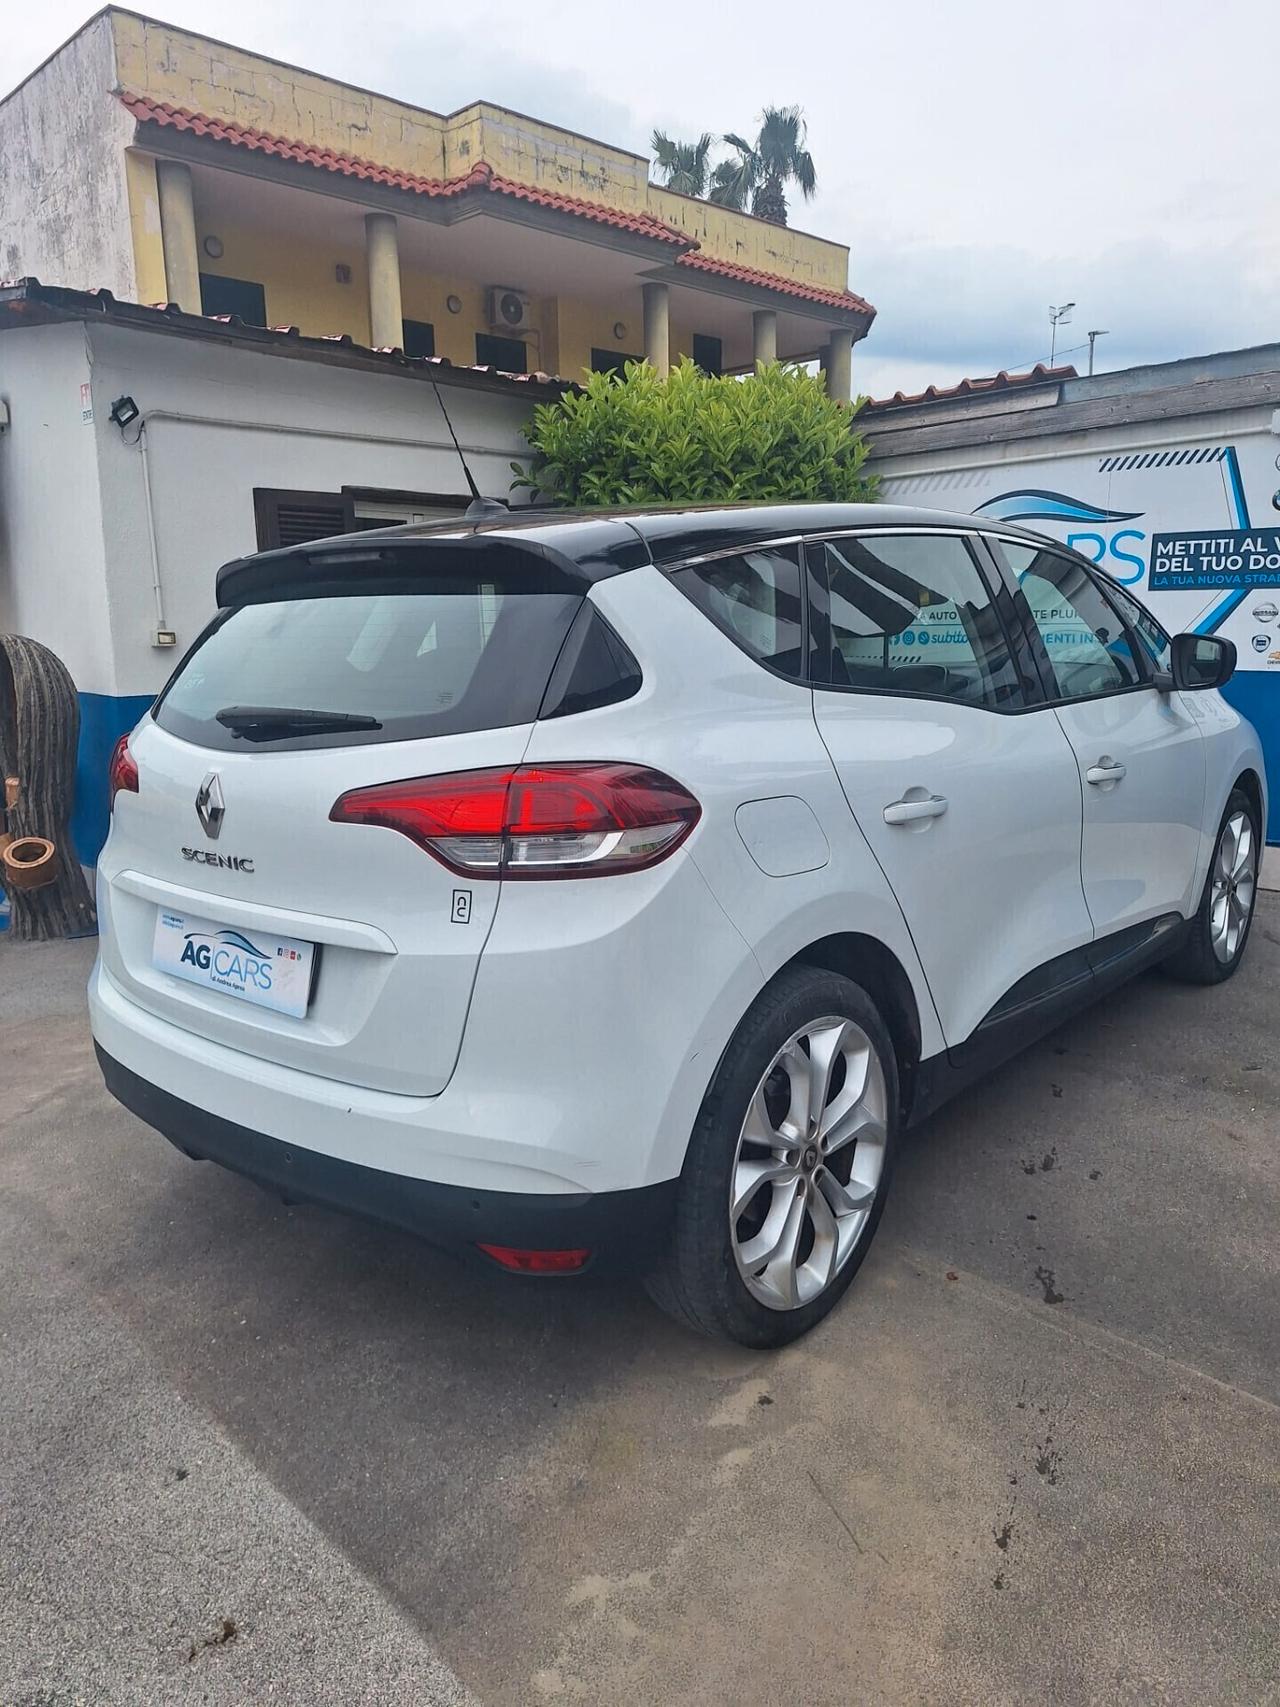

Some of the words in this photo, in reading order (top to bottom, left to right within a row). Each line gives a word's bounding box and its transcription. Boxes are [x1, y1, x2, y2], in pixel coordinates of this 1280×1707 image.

[1157, 538, 1235, 556] METTITI
[1240, 537, 1268, 553] AL
[1155, 557, 1194, 573] DEL
[1199, 555, 1243, 571] TUO
[1154, 576, 1168, 586] LA
[1172, 575, 1194, 585] TUA
[1197, 574, 1240, 584] NUOVA
[929, 611, 957, 620] AUTO
[1042, 633, 1076, 644] ENTI
[181, 847, 255, 873] SCENIC
[180, 940, 212, 970] AG
[214, 950, 273, 990] CARS
